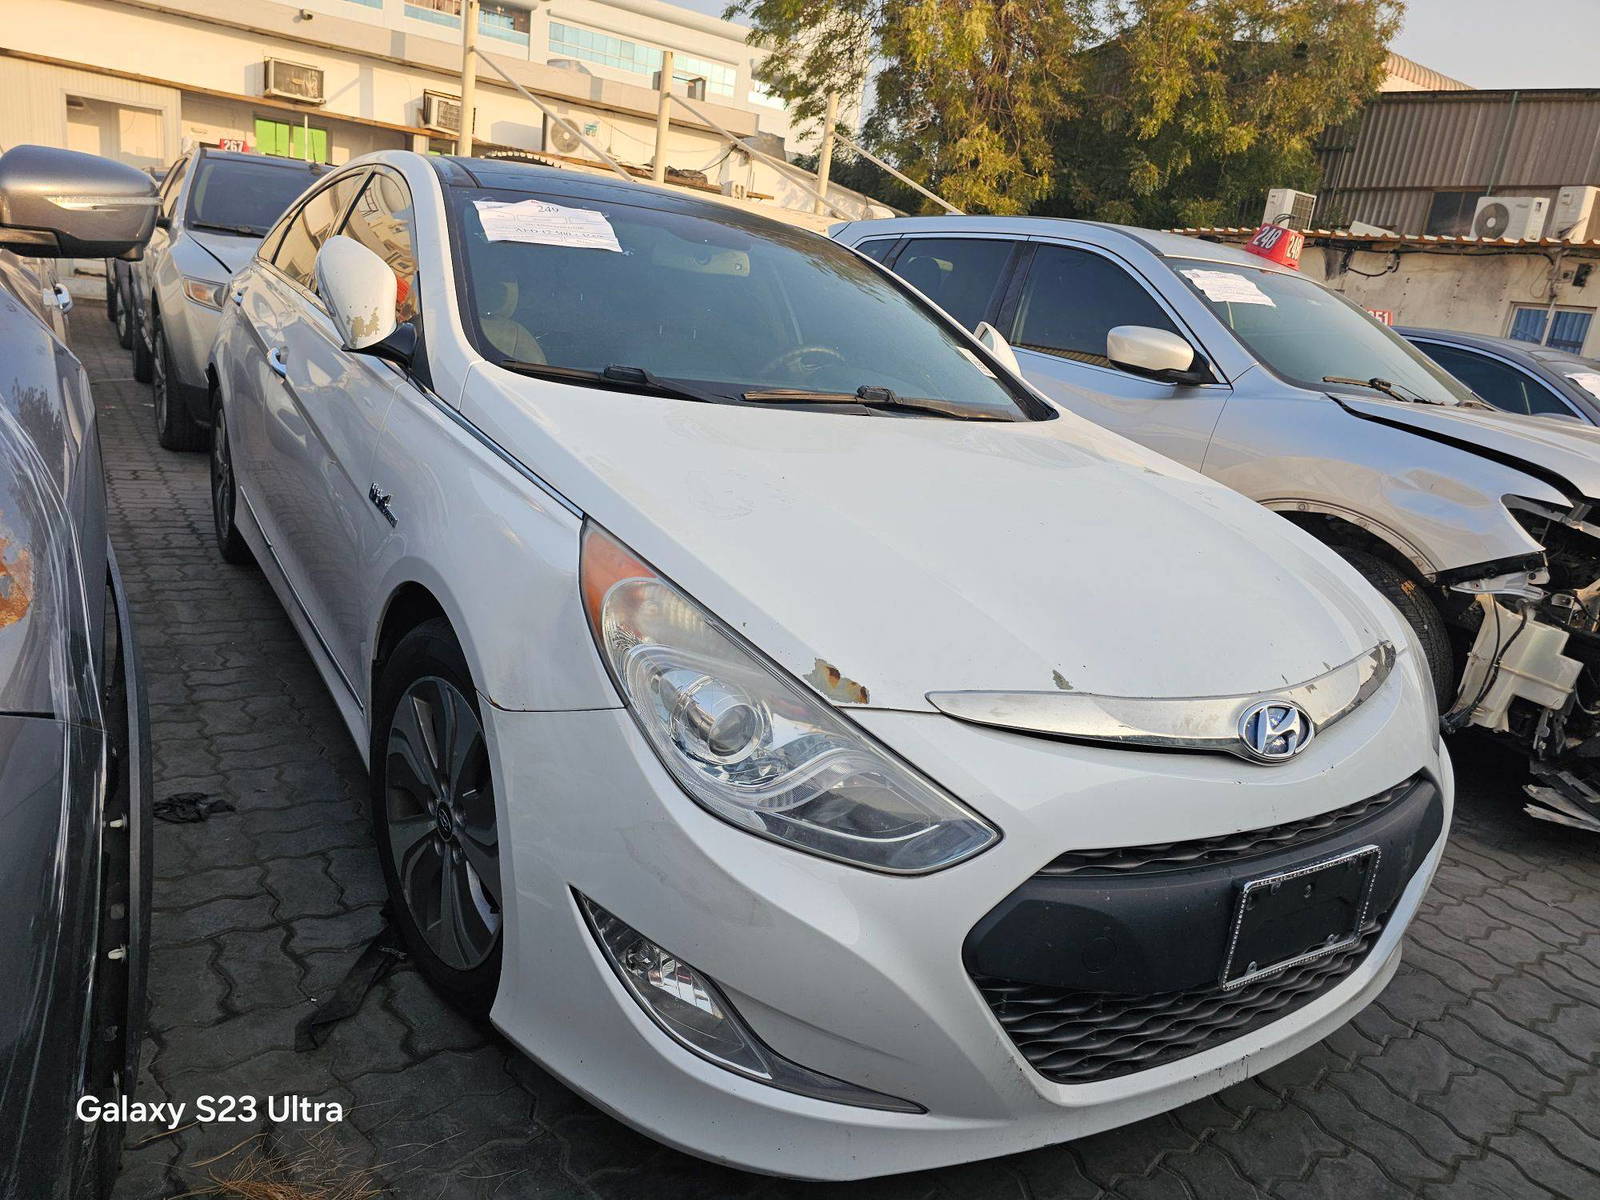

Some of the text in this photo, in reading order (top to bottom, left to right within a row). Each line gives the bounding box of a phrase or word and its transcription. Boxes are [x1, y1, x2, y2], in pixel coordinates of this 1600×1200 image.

[224, 139, 243, 152] 267
[538, 205, 560, 213] 249
[1252, 226, 1282, 249] 248
[1286, 234, 1302, 260] 248
